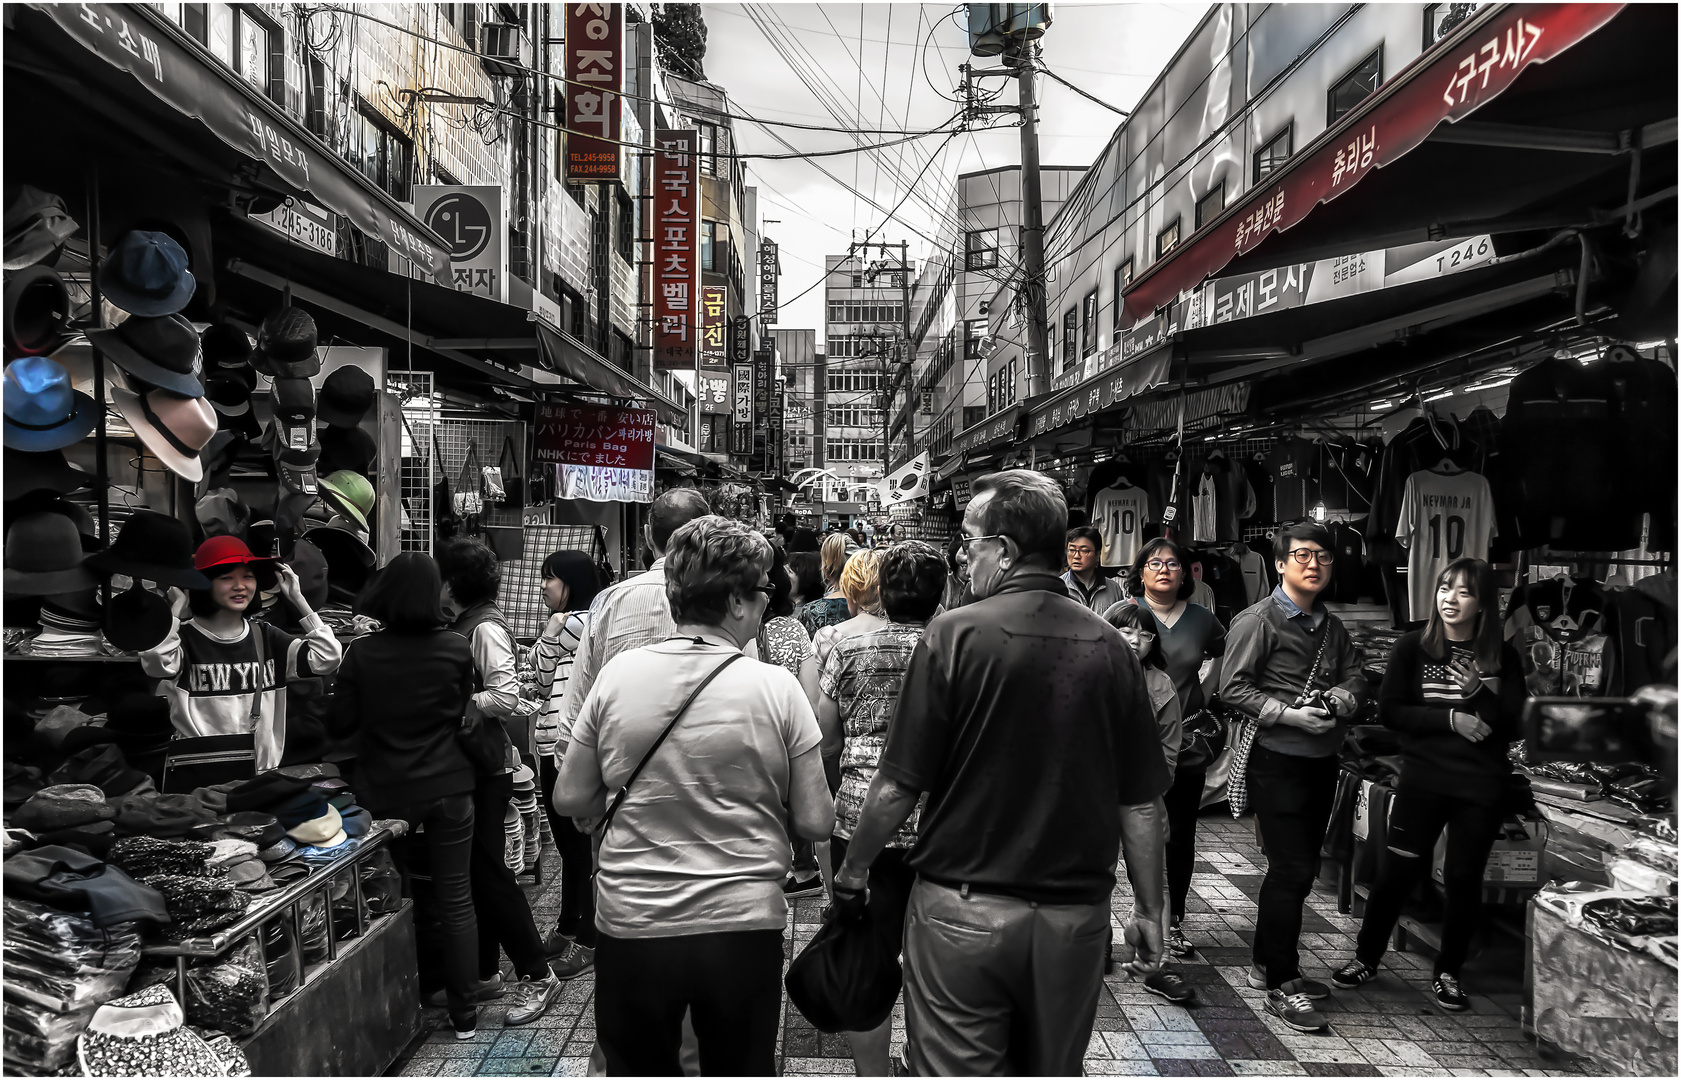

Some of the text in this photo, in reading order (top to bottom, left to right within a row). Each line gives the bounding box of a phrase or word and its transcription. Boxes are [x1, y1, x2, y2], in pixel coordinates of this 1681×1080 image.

[249, 113, 310, 182] 대일모자
[1332, 125, 1376, 187] 츄리닝
[570, 165, 616, 173] FAX.244-9958
[1234, 190, 1286, 250] 축구복전문
[390, 218, 435, 268] 단체모주문
[661, 139, 691, 342] 대국스포츠벨리
[1437, 237, 1489, 273] T 246
[1333, 258, 1366, 285] 전문업소
[703, 293, 724, 347] 금진
[564, 439, 628, 452] Paris Bag
[618, 427, 653, 443] 파리가방
[595, 452, 627, 466] ました
[1423, 494, 1471, 509] NEYMAR JR
[1112, 509, 1135, 535] 10
[1429, 513, 1466, 560] 10
[190, 662, 232, 692] NEW
